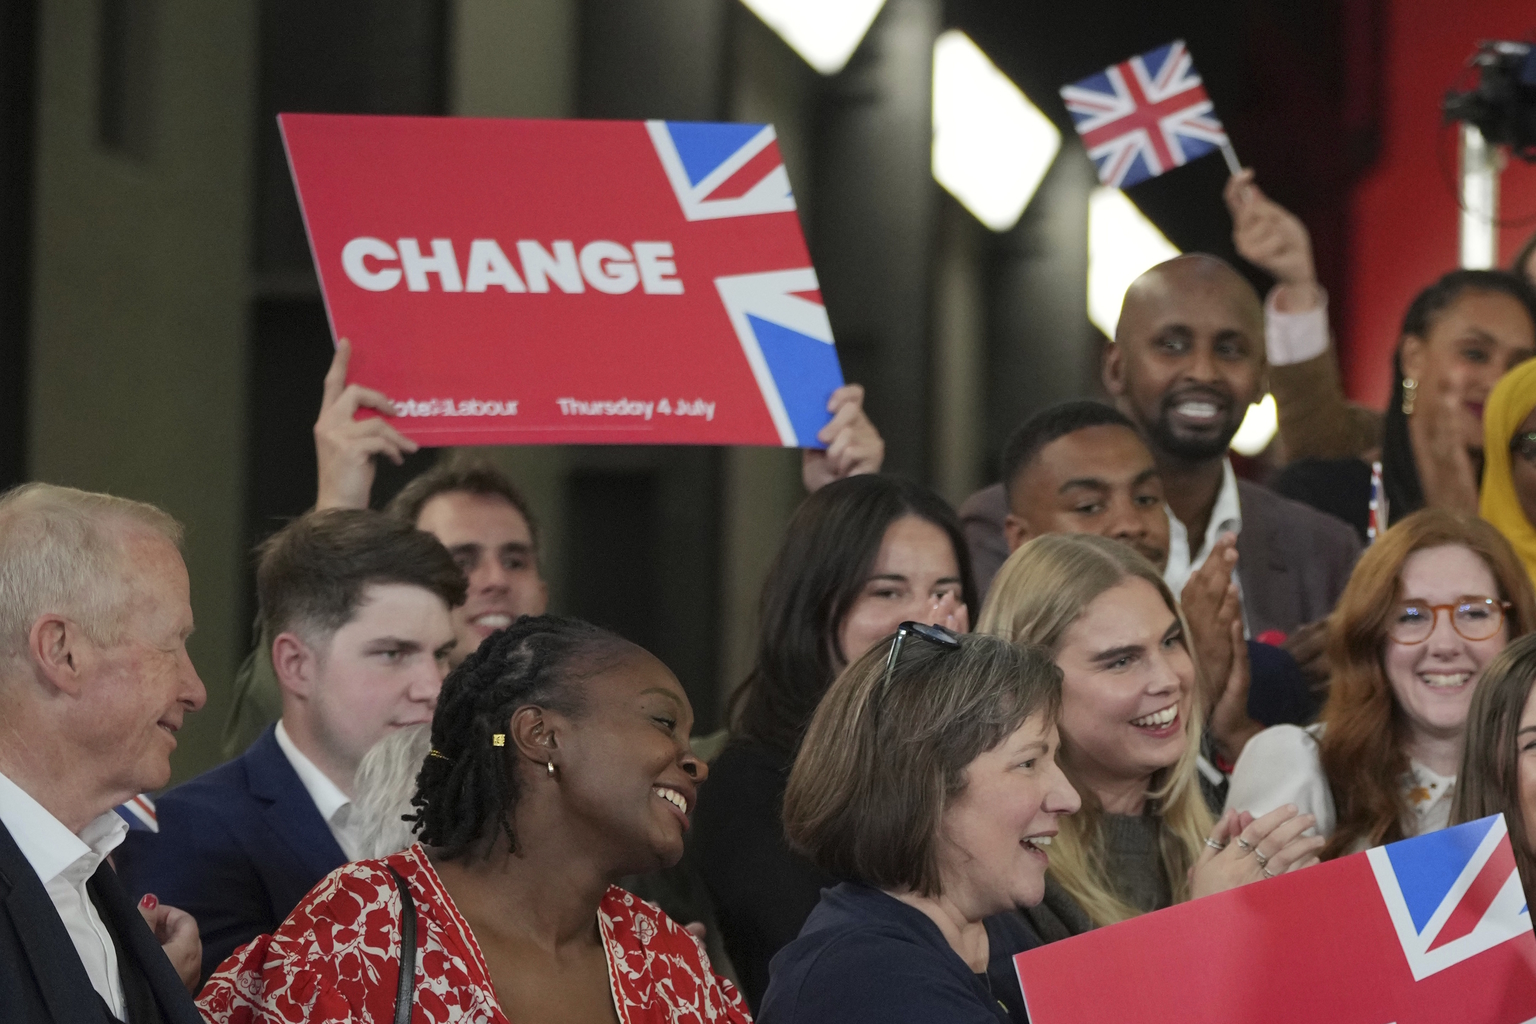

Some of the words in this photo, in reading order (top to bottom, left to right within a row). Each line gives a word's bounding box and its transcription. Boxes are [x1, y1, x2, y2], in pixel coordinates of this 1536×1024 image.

[341, 236, 686, 295] CHANGE
[388, 399, 429, 417] ote
[443, 398, 519, 417] Labour
[556, 397, 655, 421] Thursday
[656, 398, 673, 416] 4
[674, 398, 716, 422] July
